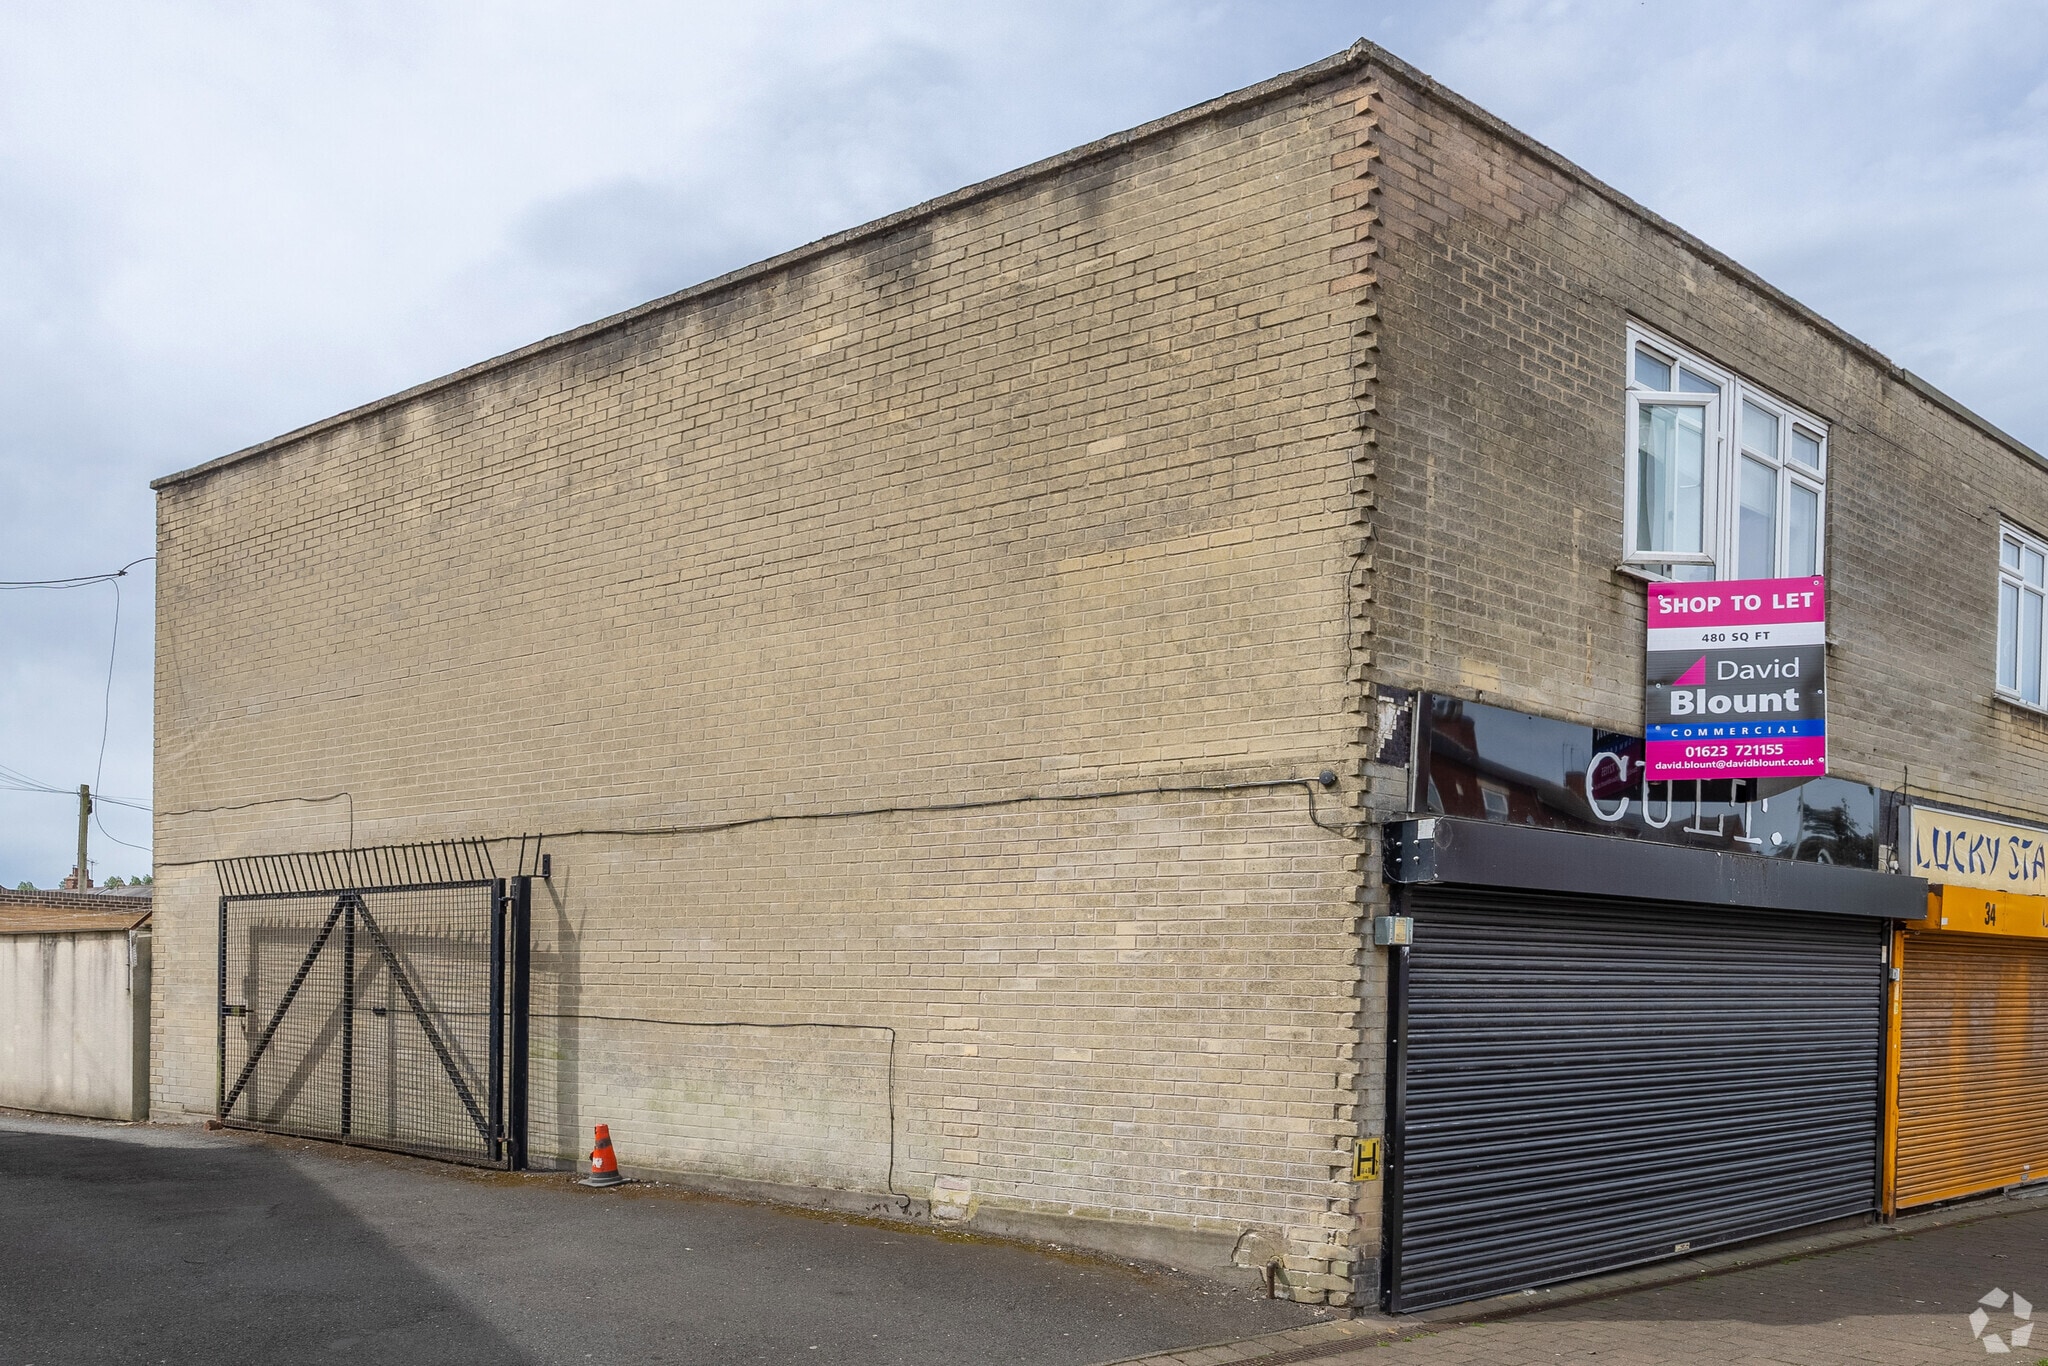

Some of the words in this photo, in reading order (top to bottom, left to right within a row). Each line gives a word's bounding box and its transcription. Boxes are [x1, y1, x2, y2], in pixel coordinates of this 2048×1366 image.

[1659, 596, 1721, 614] SHOP
[1730, 594, 1761, 611] TO
[1772, 592, 1814, 609] LET
[1701, 633, 1726, 643] 480
[1731, 632, 1749, 643] SQ
[1755, 631, 1770, 641] FT
[1717, 656, 1800, 681] David
[1670, 688, 1800, 716] Blount
[1671, 725, 1799, 737] COMMERCIAL
[1685, 745, 1728, 757] 01623
[1735, 744, 1784, 756] 721155
[1655, 757, 1814, 770] david.blount@davidblount.co.uk
[1916, 826, 2000, 876] LUCKY
[1984, 901, 1996, 927] 34
